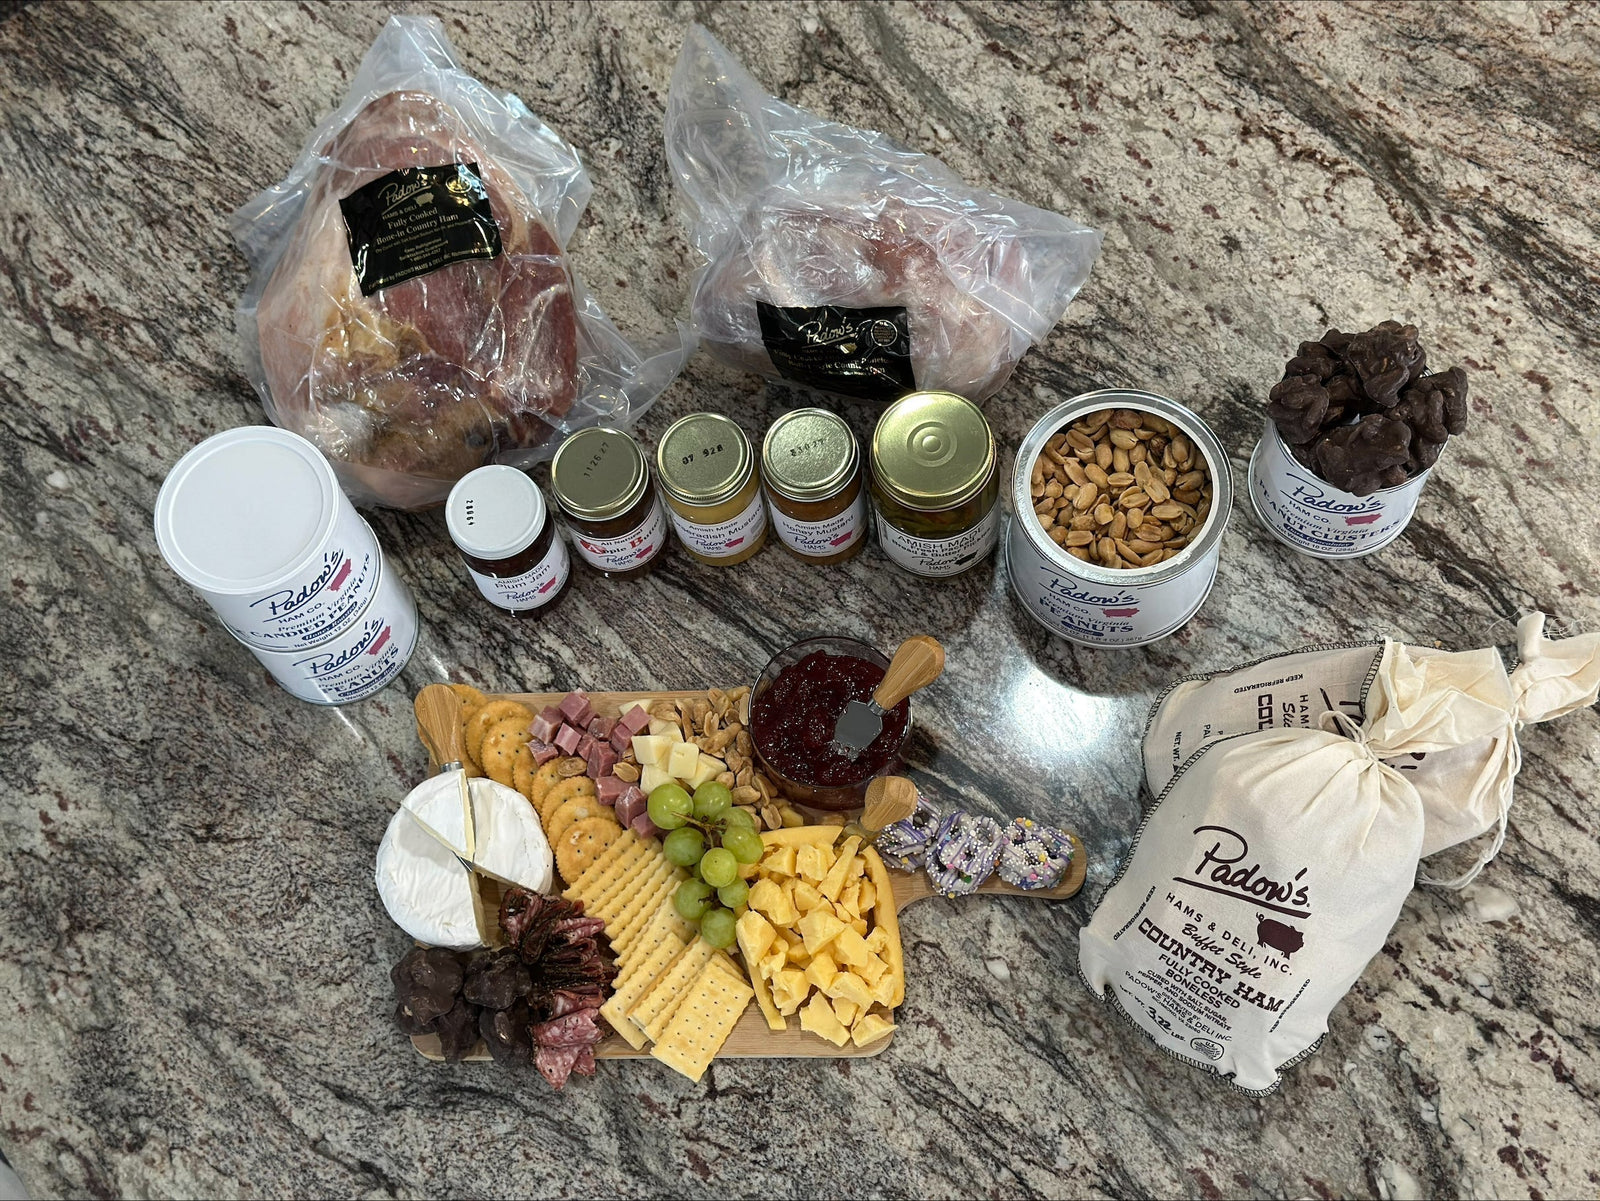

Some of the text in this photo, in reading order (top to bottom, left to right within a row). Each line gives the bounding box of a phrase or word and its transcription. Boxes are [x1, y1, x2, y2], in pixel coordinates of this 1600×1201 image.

[378, 178, 428, 206] Padow's
[376, 230, 405, 245] Bone-in
[406, 219, 438, 234] Country
[439, 214, 459, 223] Ham
[382, 211, 398, 220] HAMS
[388, 207, 438, 229] Fully Cooked
[798, 317, 852, 343] Padow's
[1286, 473, 1382, 512] Padow's
[716, 521, 738, 531] Made
[728, 504, 762, 535] Mustard
[783, 514, 854, 536] Honey Mustard
[823, 517, 844, 529] Made
[1260, 480, 1399, 541] PEANUT CLUSTERS
[1281, 504, 1322, 530] Premium
[1289, 500, 1331, 524] HAM CO.
[689, 536, 733, 547] Padow's
[787, 531, 839, 545] Padow's
[898, 535, 943, 549] AMISH
[599, 548, 642, 563] Padow's
[911, 553, 965, 566] Padow's
[249, 550, 339, 616] Padow's
[495, 564, 550, 590] Plum Jam
[498, 582, 545, 600] Padow's
[1040, 566, 1136, 604] Padow's
[250, 553, 370, 639] CANDIED PEANUTS
[278, 577, 356, 632] Premium Virginia
[1043, 596, 1083, 620] Premium
[1088, 617, 1129, 627] Virginia
[1049, 593, 1091, 615] HAM CO.
[278, 613, 305, 624] HAM
[1040, 597, 1134, 633] PEANUTS
[292, 619, 379, 675] Padow's
[309, 631, 333, 645] Weight
[318, 643, 394, 688] Premium Virginia
[318, 672, 343, 682] HAM
[321, 647, 399, 694] PEANUTS
[1234, 674, 1303, 694] KEEP REFRIGERATED
[1300, 694, 1310, 729] HAM
[1193, 825, 1309, 906] Padow's
[1113, 902, 1146, 940] REFRIGERATED
[1166, 892, 1292, 975] HAMS & DELI, INC.
[1138, 917, 1284, 1012] COUNTRY HAM
[1182, 923, 1262, 978] Buffet Style
[1147, 970, 1170, 985] CURED
[1171, 983, 1187, 997] WITH
[1159, 954, 1240, 1008] FULLY COOKED
[1165, 969, 1223, 1009] BONELESS
[1125, 971, 1161, 999] PADOW'S
[1163, 998, 1186, 1018] HAMS
[1195, 1021, 1215, 1036] DELI
[1164, 986, 1178, 997] AND
[1179, 996, 1205, 1015] SODIUM
[1205, 1013, 1232, 1031] NITRATE
